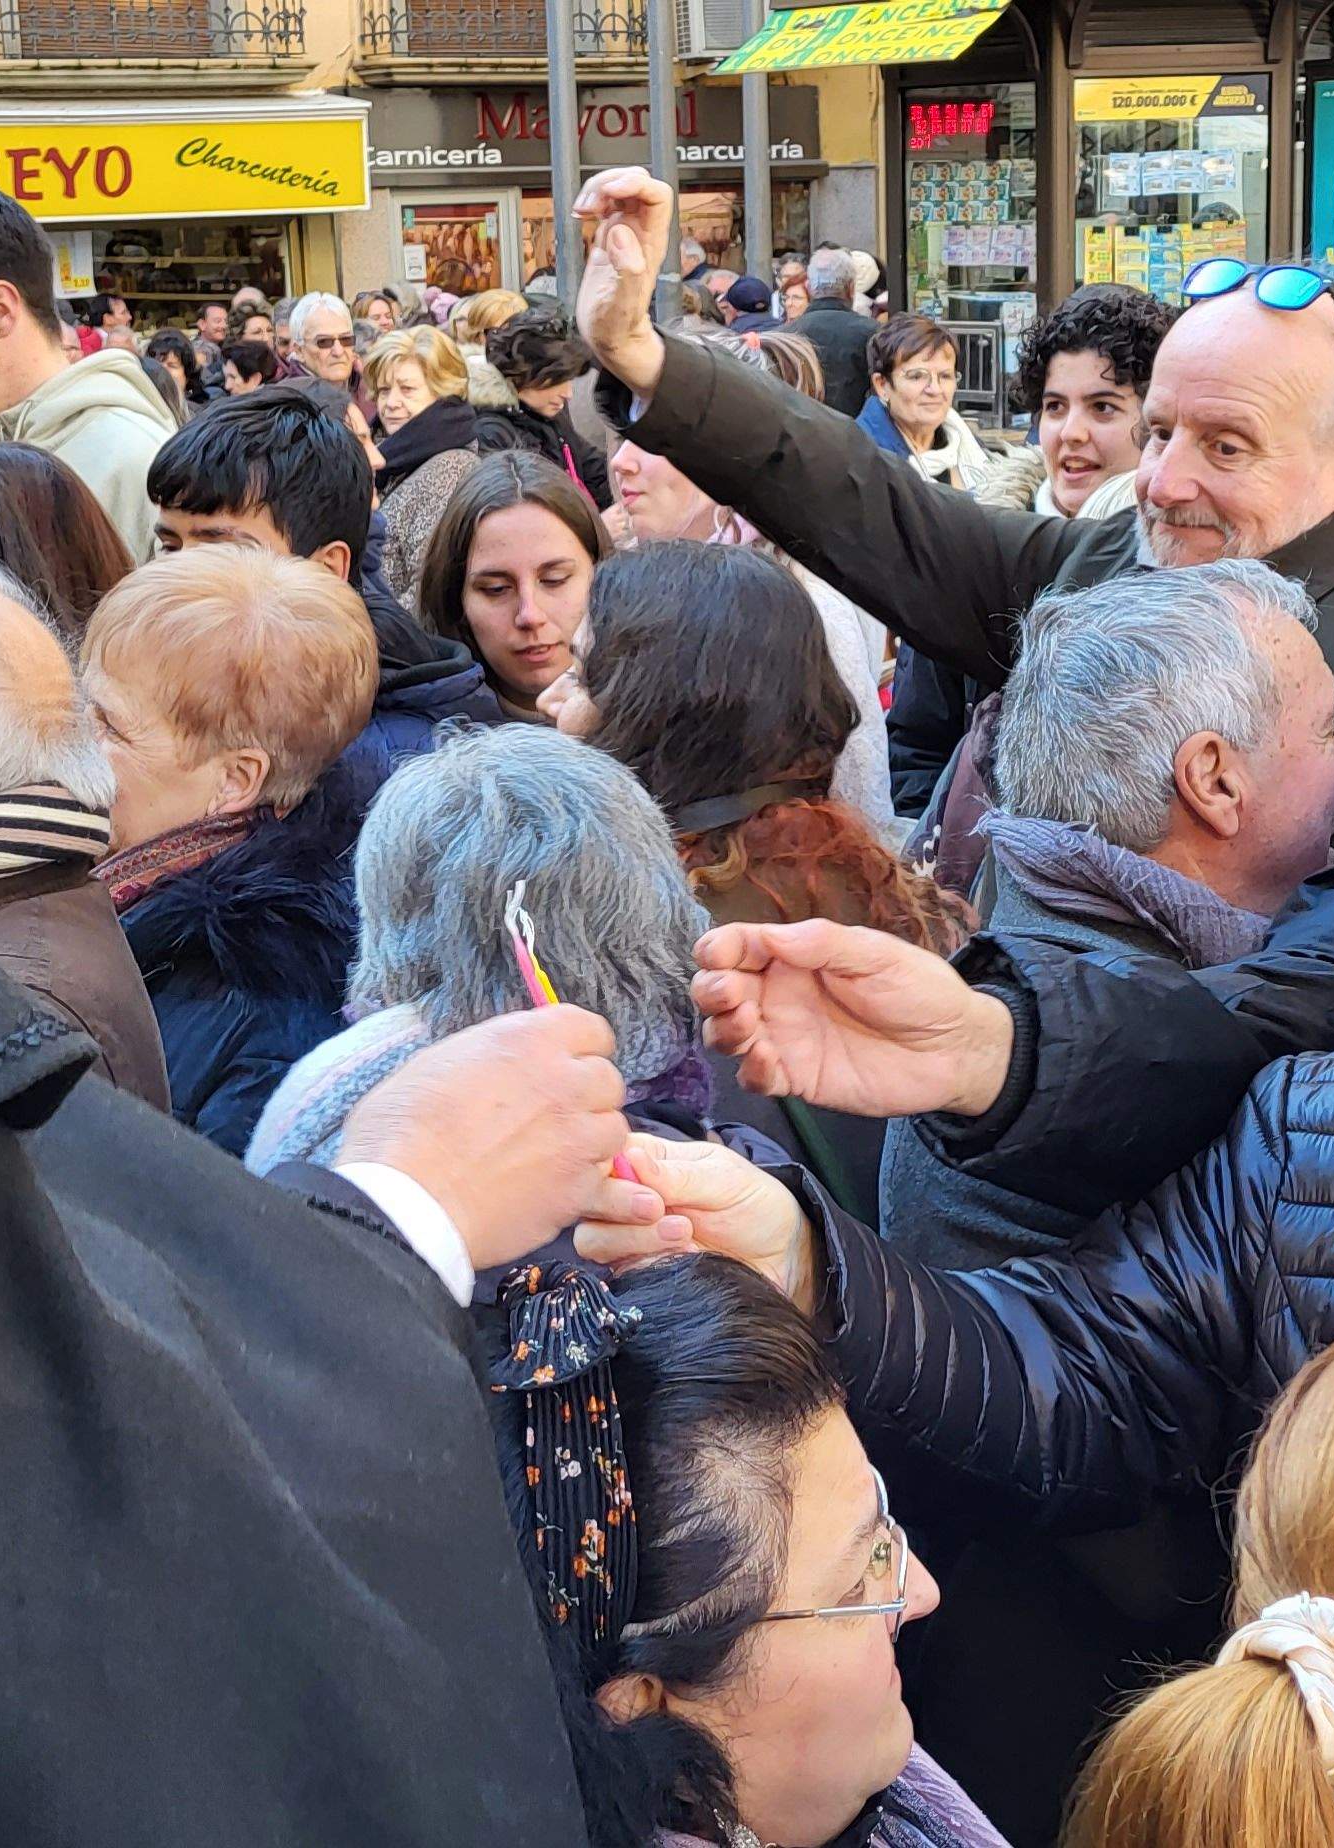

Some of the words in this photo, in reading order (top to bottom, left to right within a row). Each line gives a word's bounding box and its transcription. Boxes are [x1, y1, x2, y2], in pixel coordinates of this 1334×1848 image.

[837, 27, 917, 45] ONCE
[813, 46, 891, 63] ONCE
[474, 91, 698, 152] Mayorl
[675, 138, 804, 162] arcuría
[175, 137, 340, 196] Charcutería
